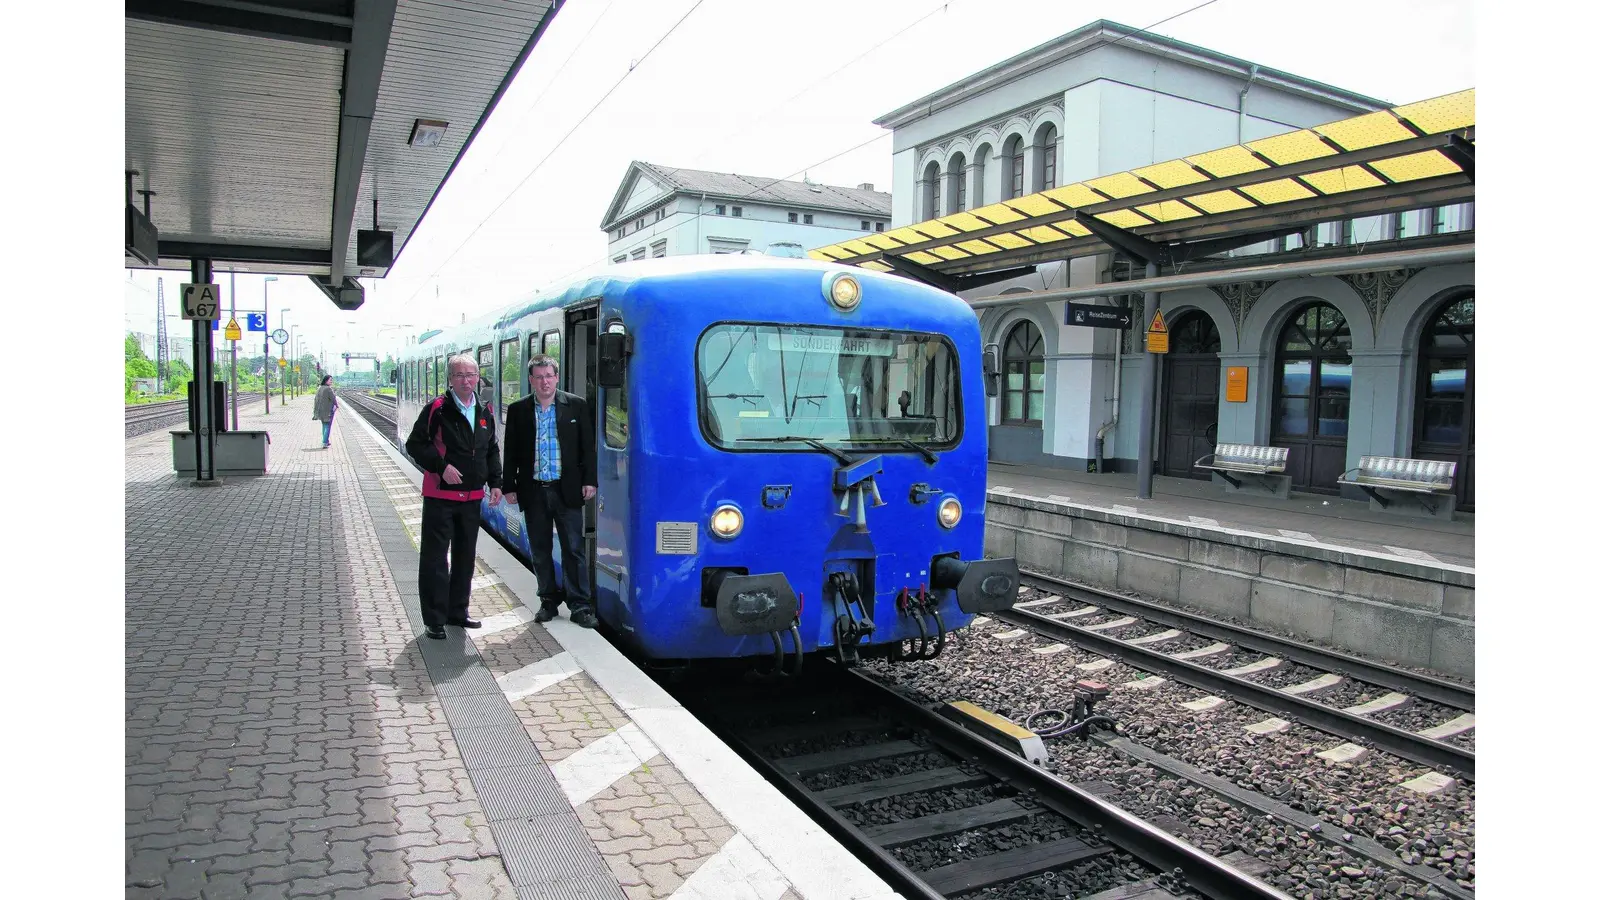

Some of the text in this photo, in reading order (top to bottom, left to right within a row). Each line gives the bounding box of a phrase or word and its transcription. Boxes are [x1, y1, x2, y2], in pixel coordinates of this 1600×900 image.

[200, 287, 214, 301] A
[196, 303, 217, 317] 67
[254, 313, 265, 328] 3
